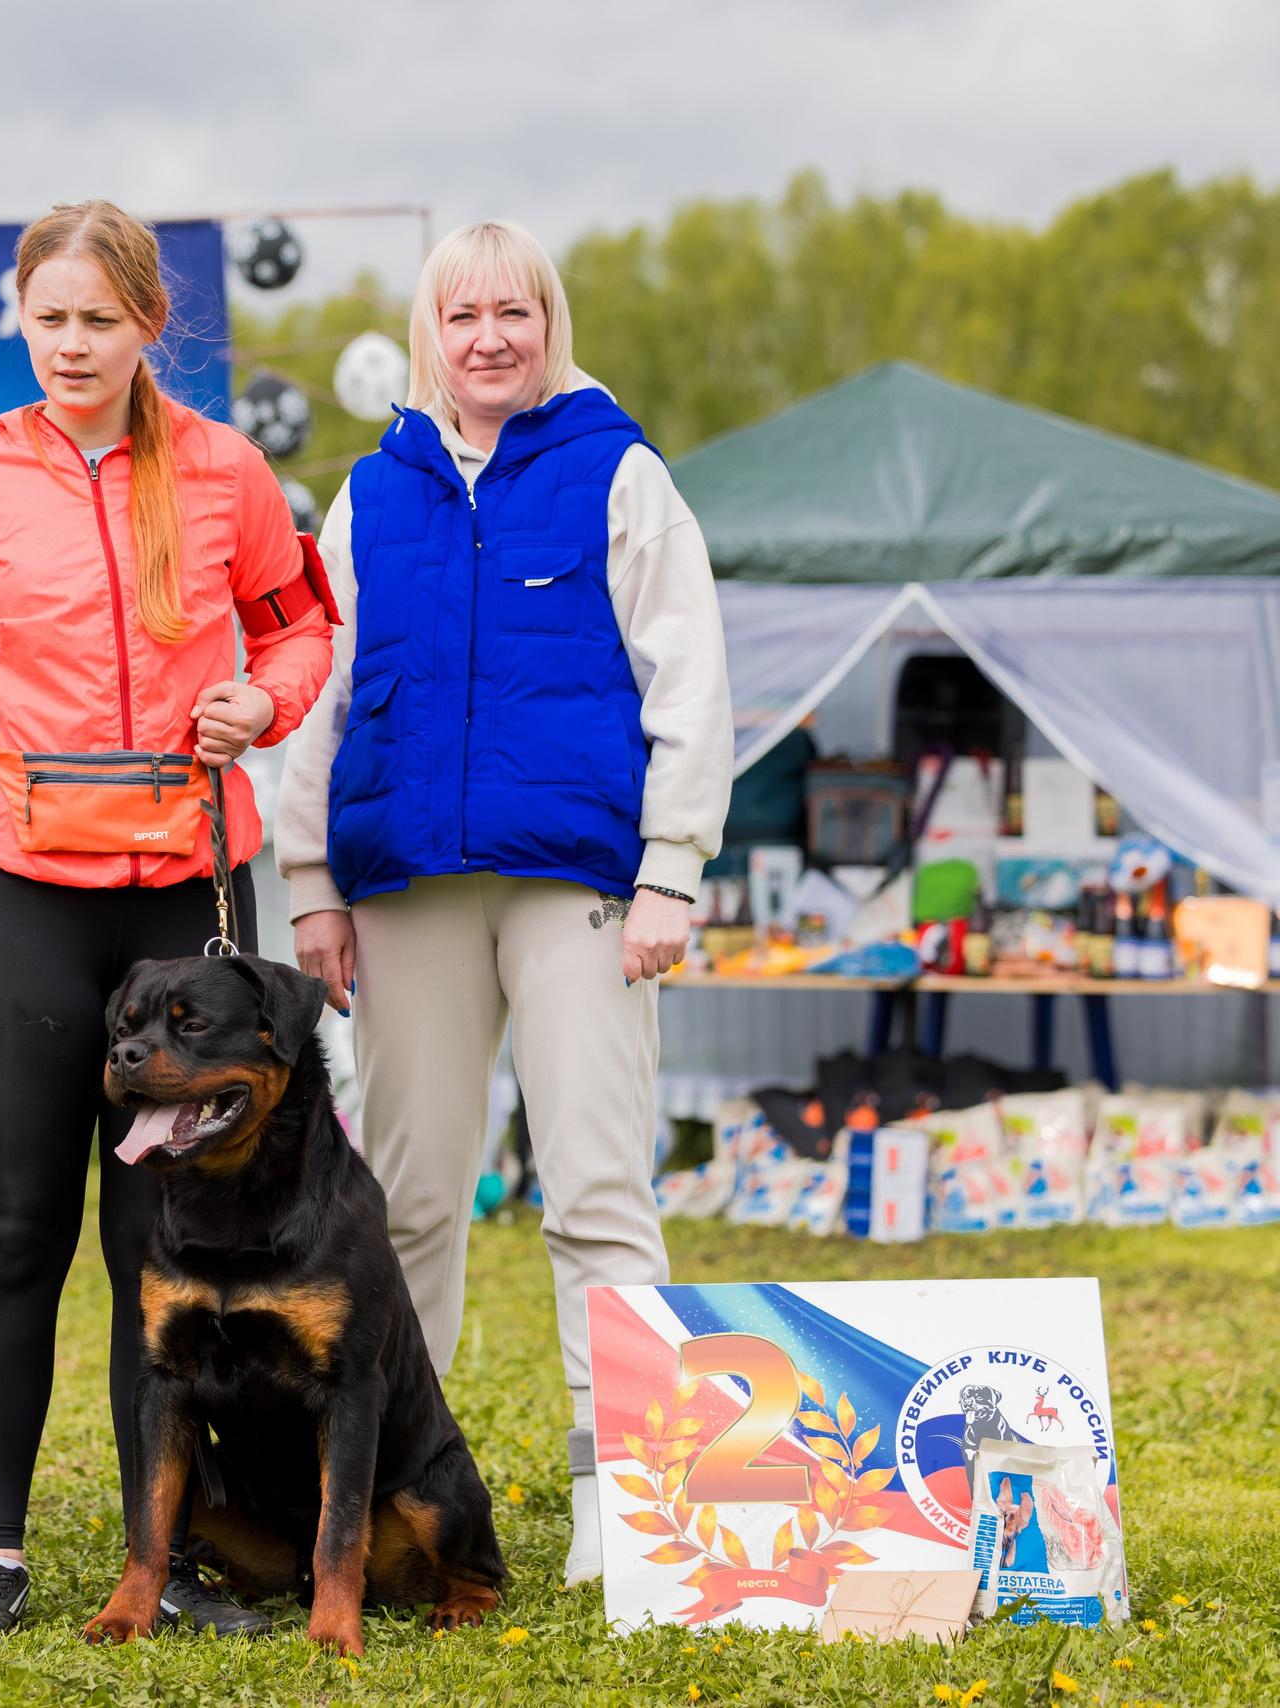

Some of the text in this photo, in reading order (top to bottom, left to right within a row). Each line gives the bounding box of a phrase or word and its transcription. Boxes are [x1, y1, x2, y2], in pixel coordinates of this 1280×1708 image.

[134, 831, 170, 841] SPORT
[678, 1332, 812, 1505] 2
[901, 1351, 1108, 1464] РОТВЕЙЛЕР КЛУБ РОССИИ
[1009, 1575, 1066, 1589] STATERA
